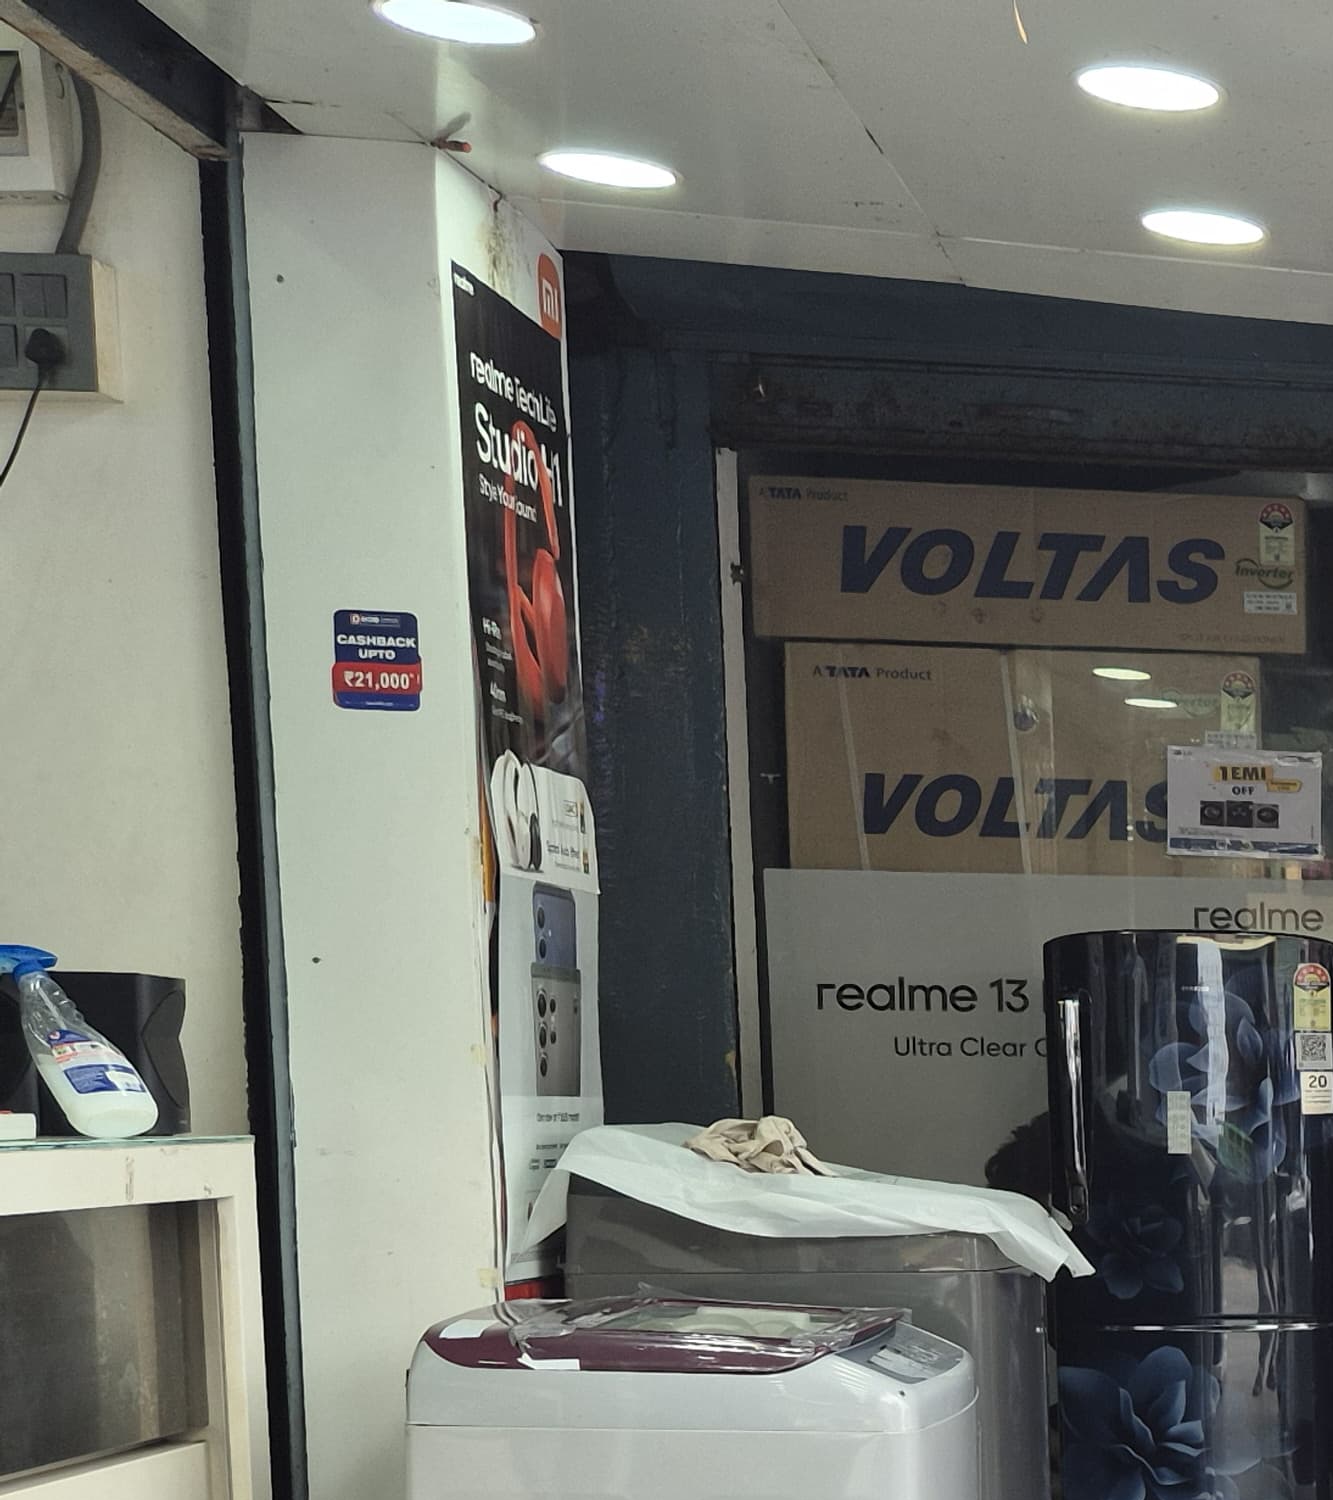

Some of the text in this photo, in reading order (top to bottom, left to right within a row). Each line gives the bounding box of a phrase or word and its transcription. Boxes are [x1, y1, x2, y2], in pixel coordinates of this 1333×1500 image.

[470, 351, 514, 402] realme
[474, 401, 539, 491] Studio
[767, 487, 849, 501] TATA Product
[840, 524, 1226, 605] VOLTAS
[336, 634, 417, 649] CASHBACK
[358, 648, 396, 660] UPTO
[825, 665, 870, 678] TATA
[876, 667, 933, 681] Product
[1231, 785, 1254, 796] OFF
[1193, 902, 1324, 931] realme
[816, 977, 1029, 1013] realme 13
[894, 1035, 953, 1058] Ultra
[960, 1036, 1027, 1058] Clear
[1308, 1075, 1328, 1089] 20
